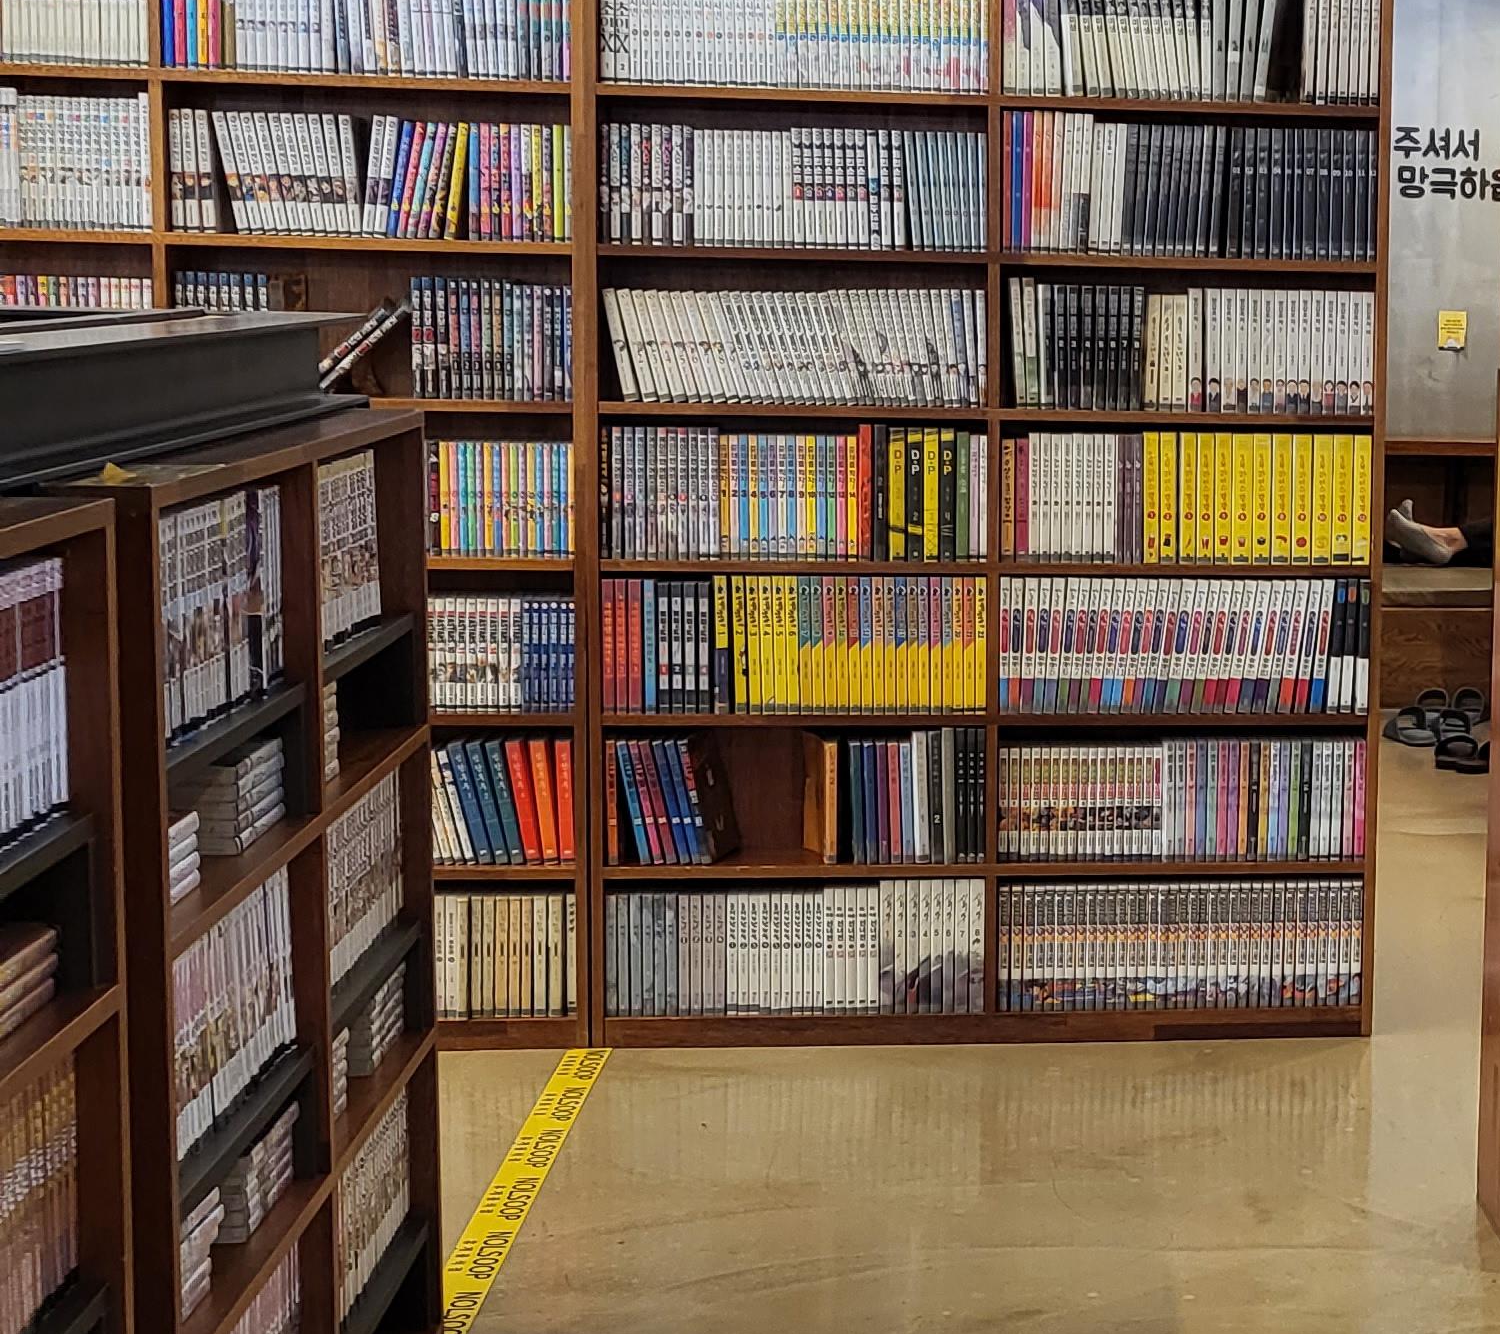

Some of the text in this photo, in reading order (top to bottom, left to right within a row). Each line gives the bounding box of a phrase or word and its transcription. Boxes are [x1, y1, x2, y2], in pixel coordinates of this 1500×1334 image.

[1394, 126, 1480, 161] 주셔서
[527, 1129, 565, 1168] NOLSOOP
[498, 1177, 540, 1221] NOLSOOP
[467, 1231, 513, 1280] NOLSOOP
